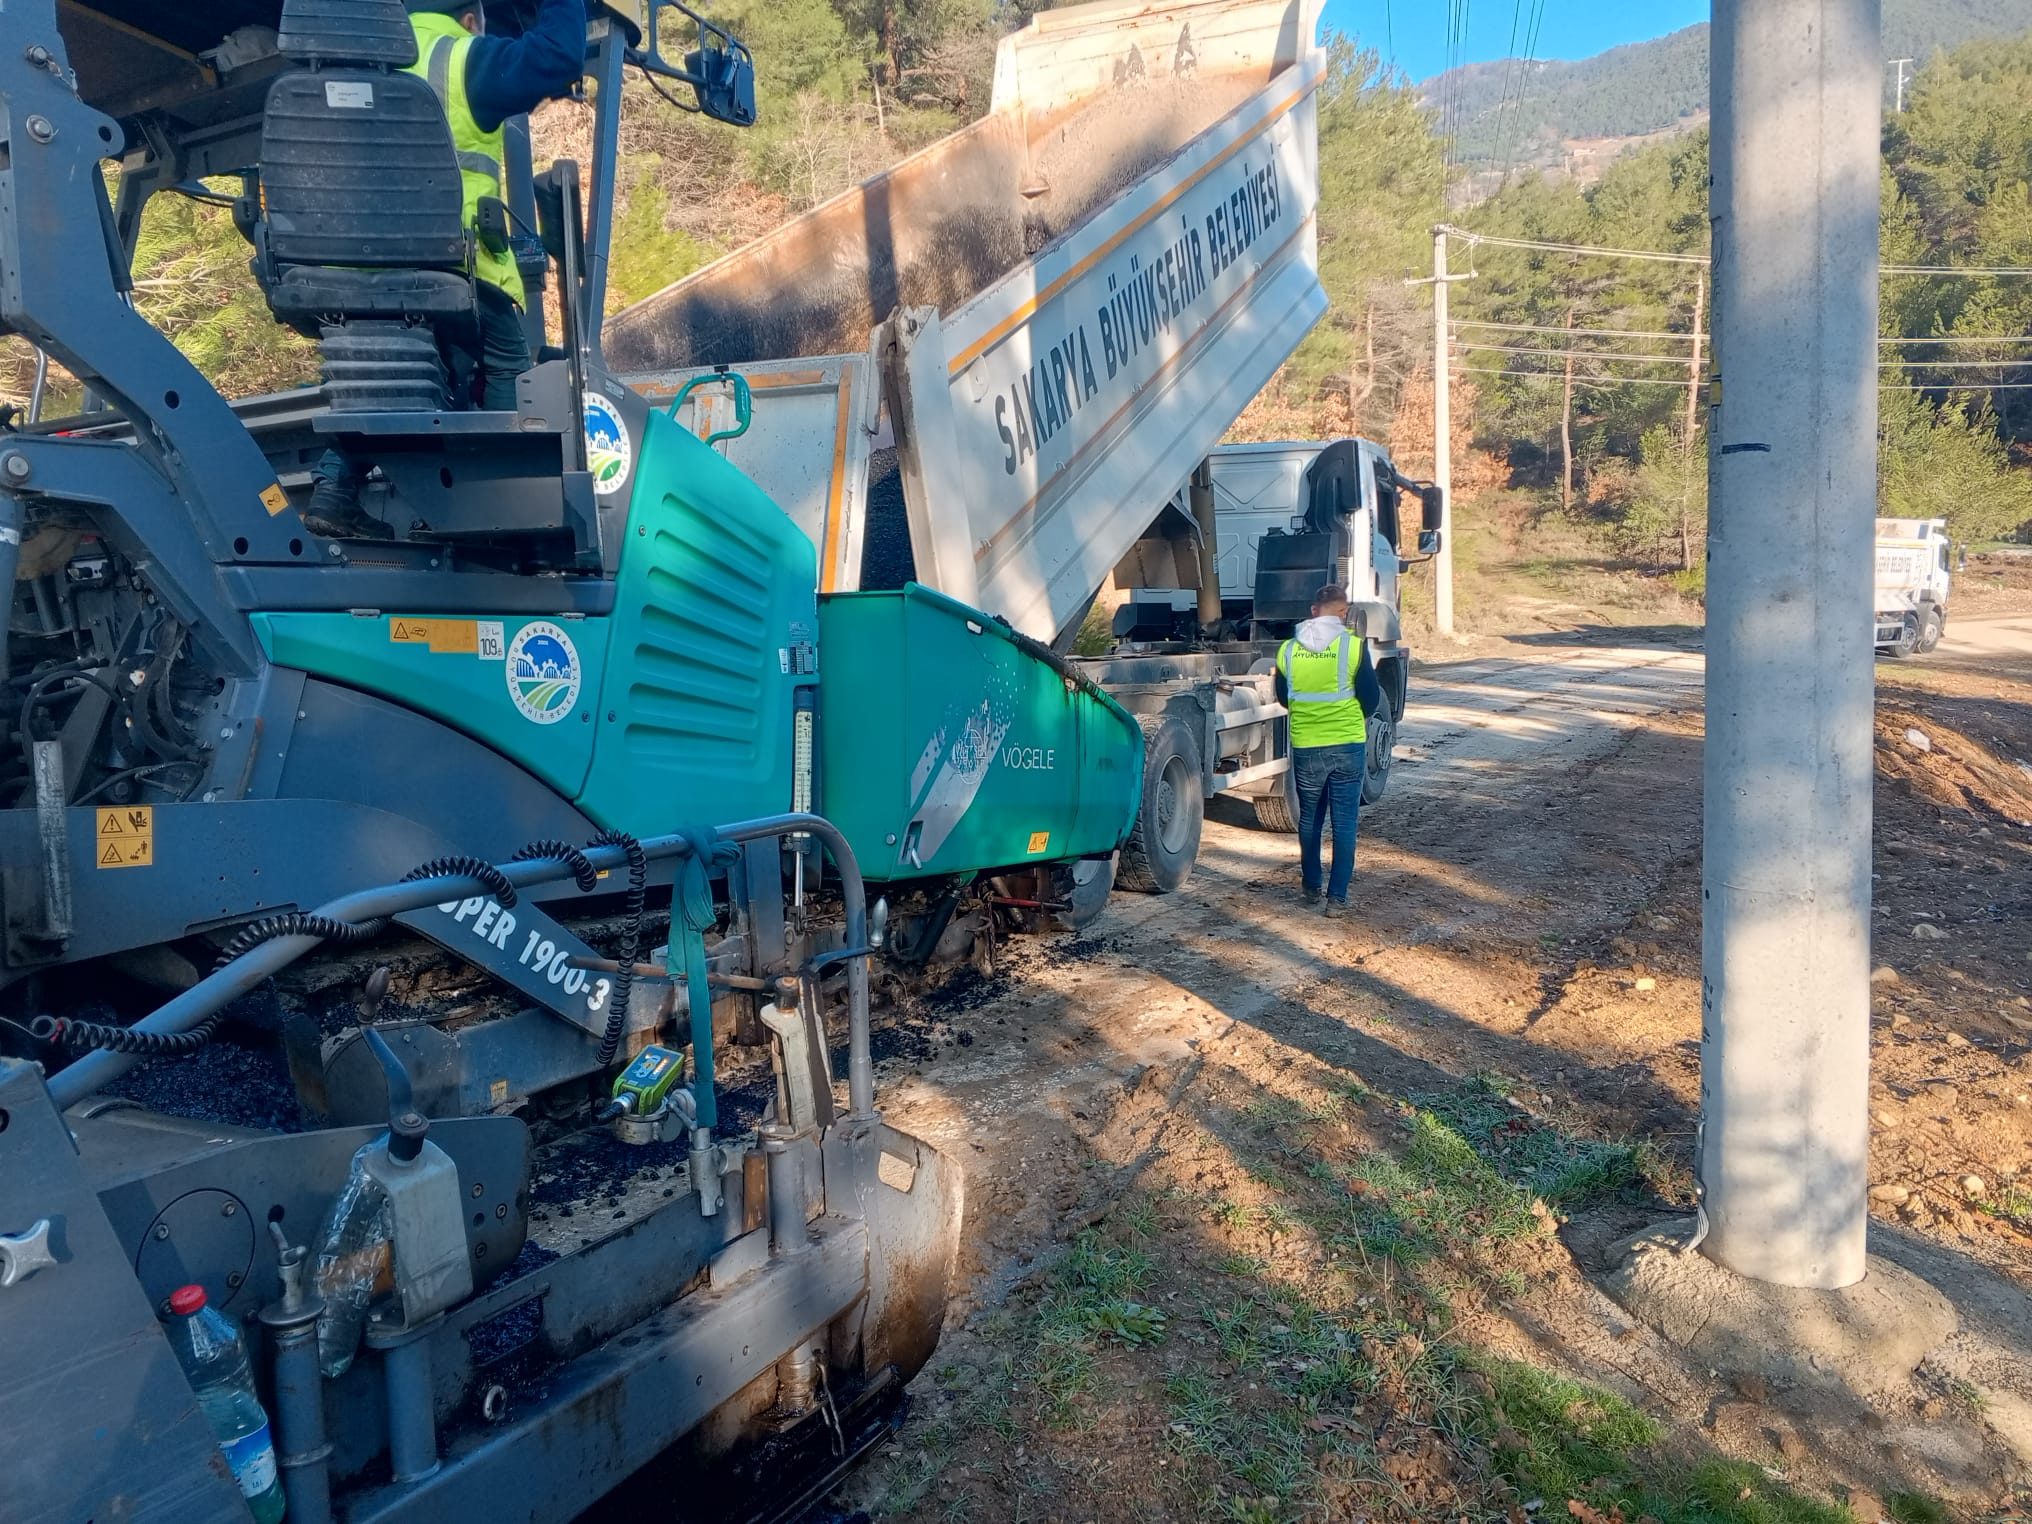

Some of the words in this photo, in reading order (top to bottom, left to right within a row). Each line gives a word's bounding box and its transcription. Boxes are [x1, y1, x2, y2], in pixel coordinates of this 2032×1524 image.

[995, 325, 1098, 475] SAKARYA
[1098, 214, 1206, 381] BÜYÜKŞEHİR
[1206, 142, 1281, 280] BELEDİYESİ
[480, 638, 498, 656] 109
[1002, 742, 1055, 770] VÖGELE
[518, 929, 611, 1011] 1900-3
